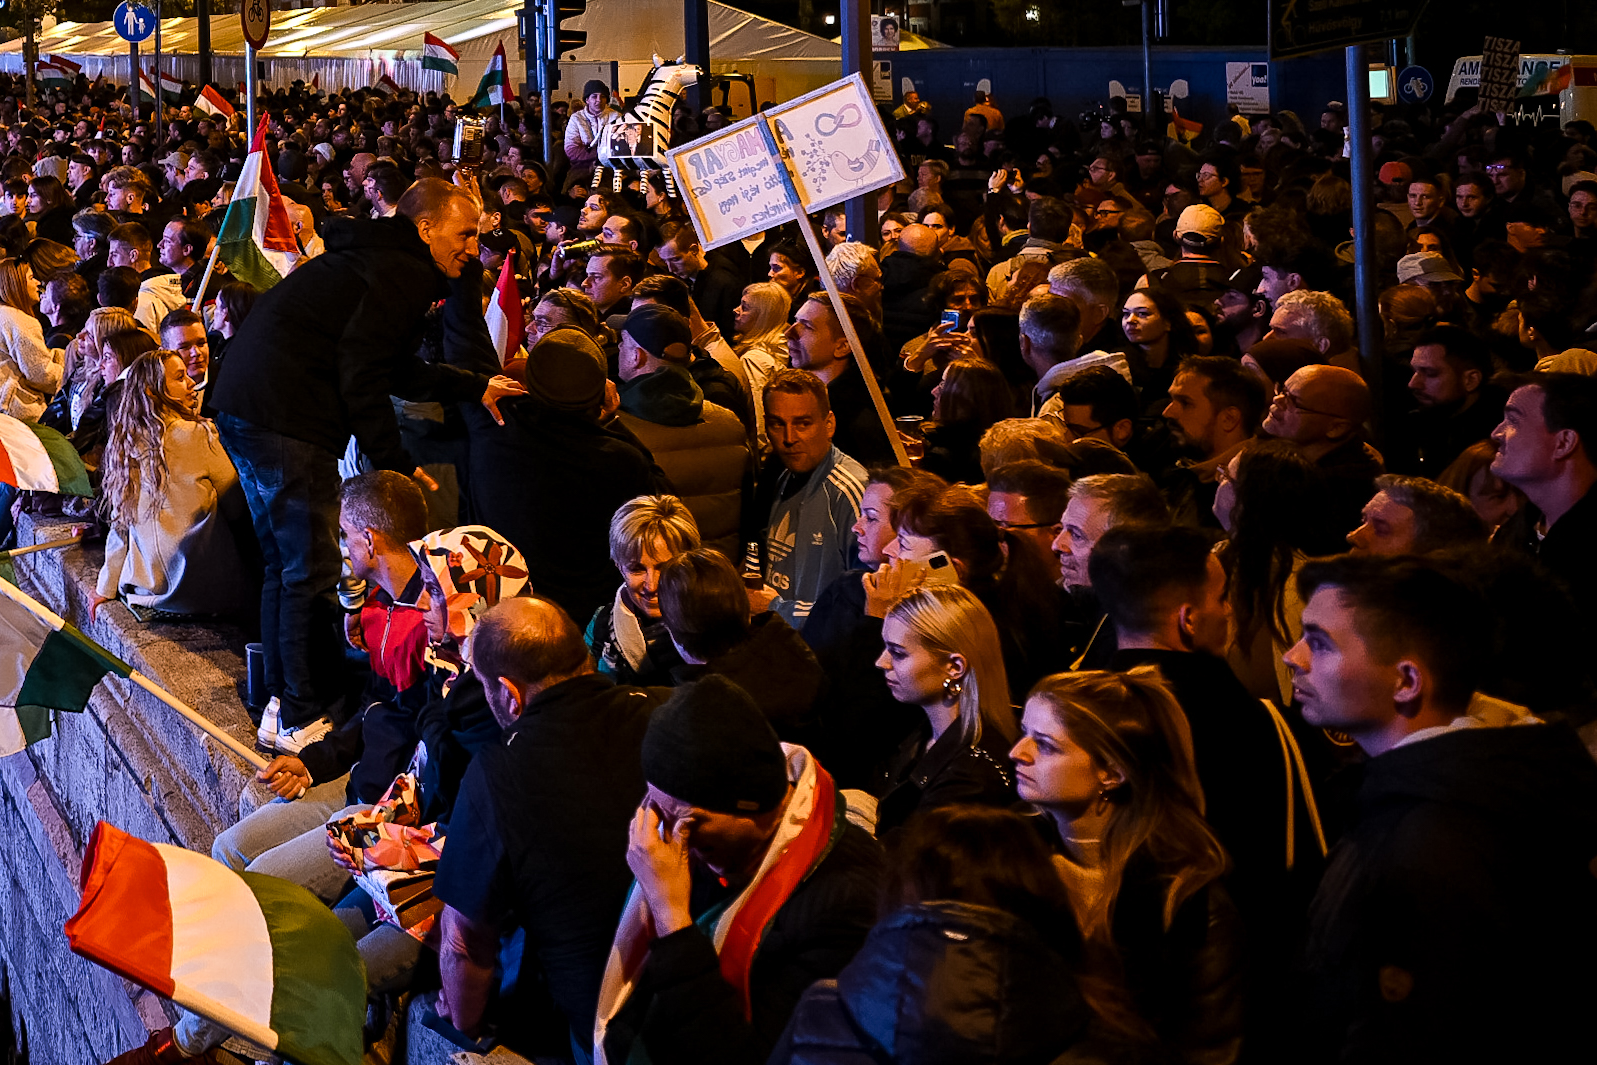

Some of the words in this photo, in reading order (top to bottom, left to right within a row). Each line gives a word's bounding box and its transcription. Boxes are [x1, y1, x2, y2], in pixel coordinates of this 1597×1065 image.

[1484, 36, 1521, 54] TISZA
[1483, 51, 1519, 69] TISZA
[1481, 66, 1517, 84] TISZA
[1479, 82, 1516, 99] TISZA
[1478, 97, 1515, 114] TISZA
